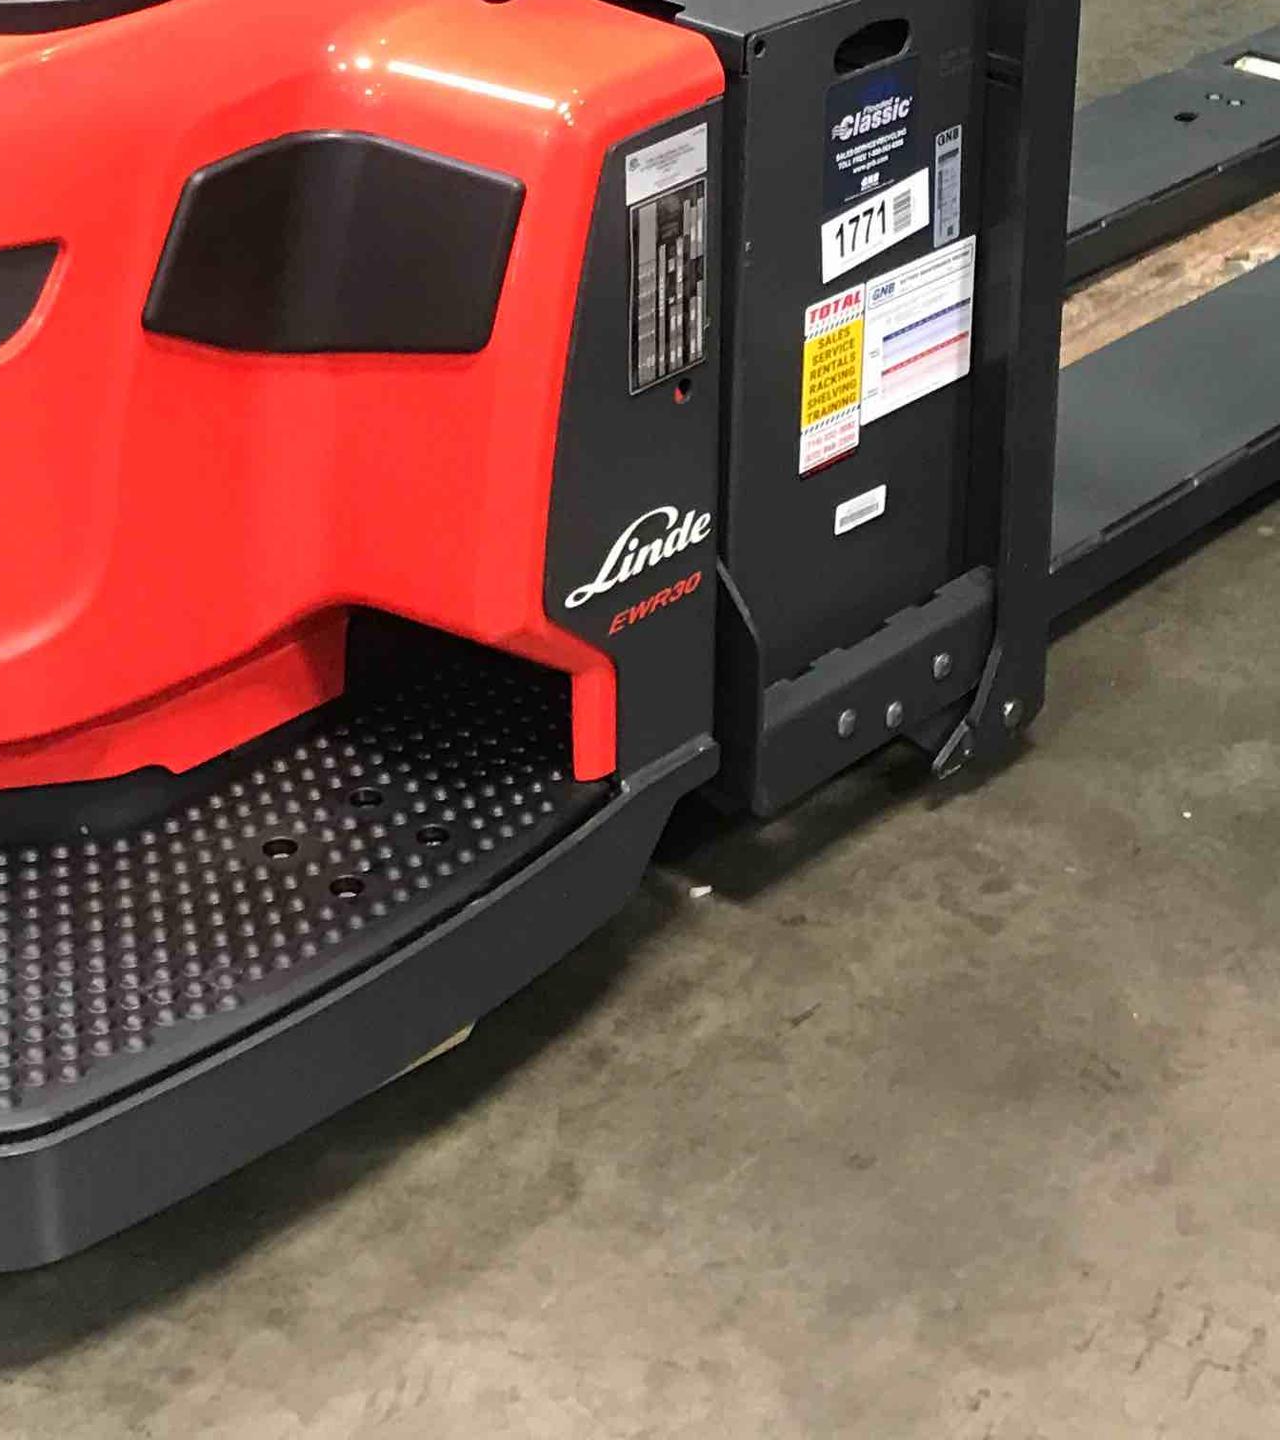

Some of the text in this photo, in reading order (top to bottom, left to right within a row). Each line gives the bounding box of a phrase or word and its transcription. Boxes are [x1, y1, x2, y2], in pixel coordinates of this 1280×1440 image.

[838, 97, 911, 141] Classic
[835, 200, 885, 258] 1771
[809, 290, 861, 323] TOTAL
[812, 339, 855, 366] SERVICE
[818, 326, 851, 349] SALES
[809, 353, 856, 381] RENTALS
[809, 367, 856, 394] RACKING
[807, 380, 857, 409] SHELVING
[807, 393, 857, 423] TRAINING
[565, 506, 711, 608] Linde
[608, 571, 702, 635] EWR30
